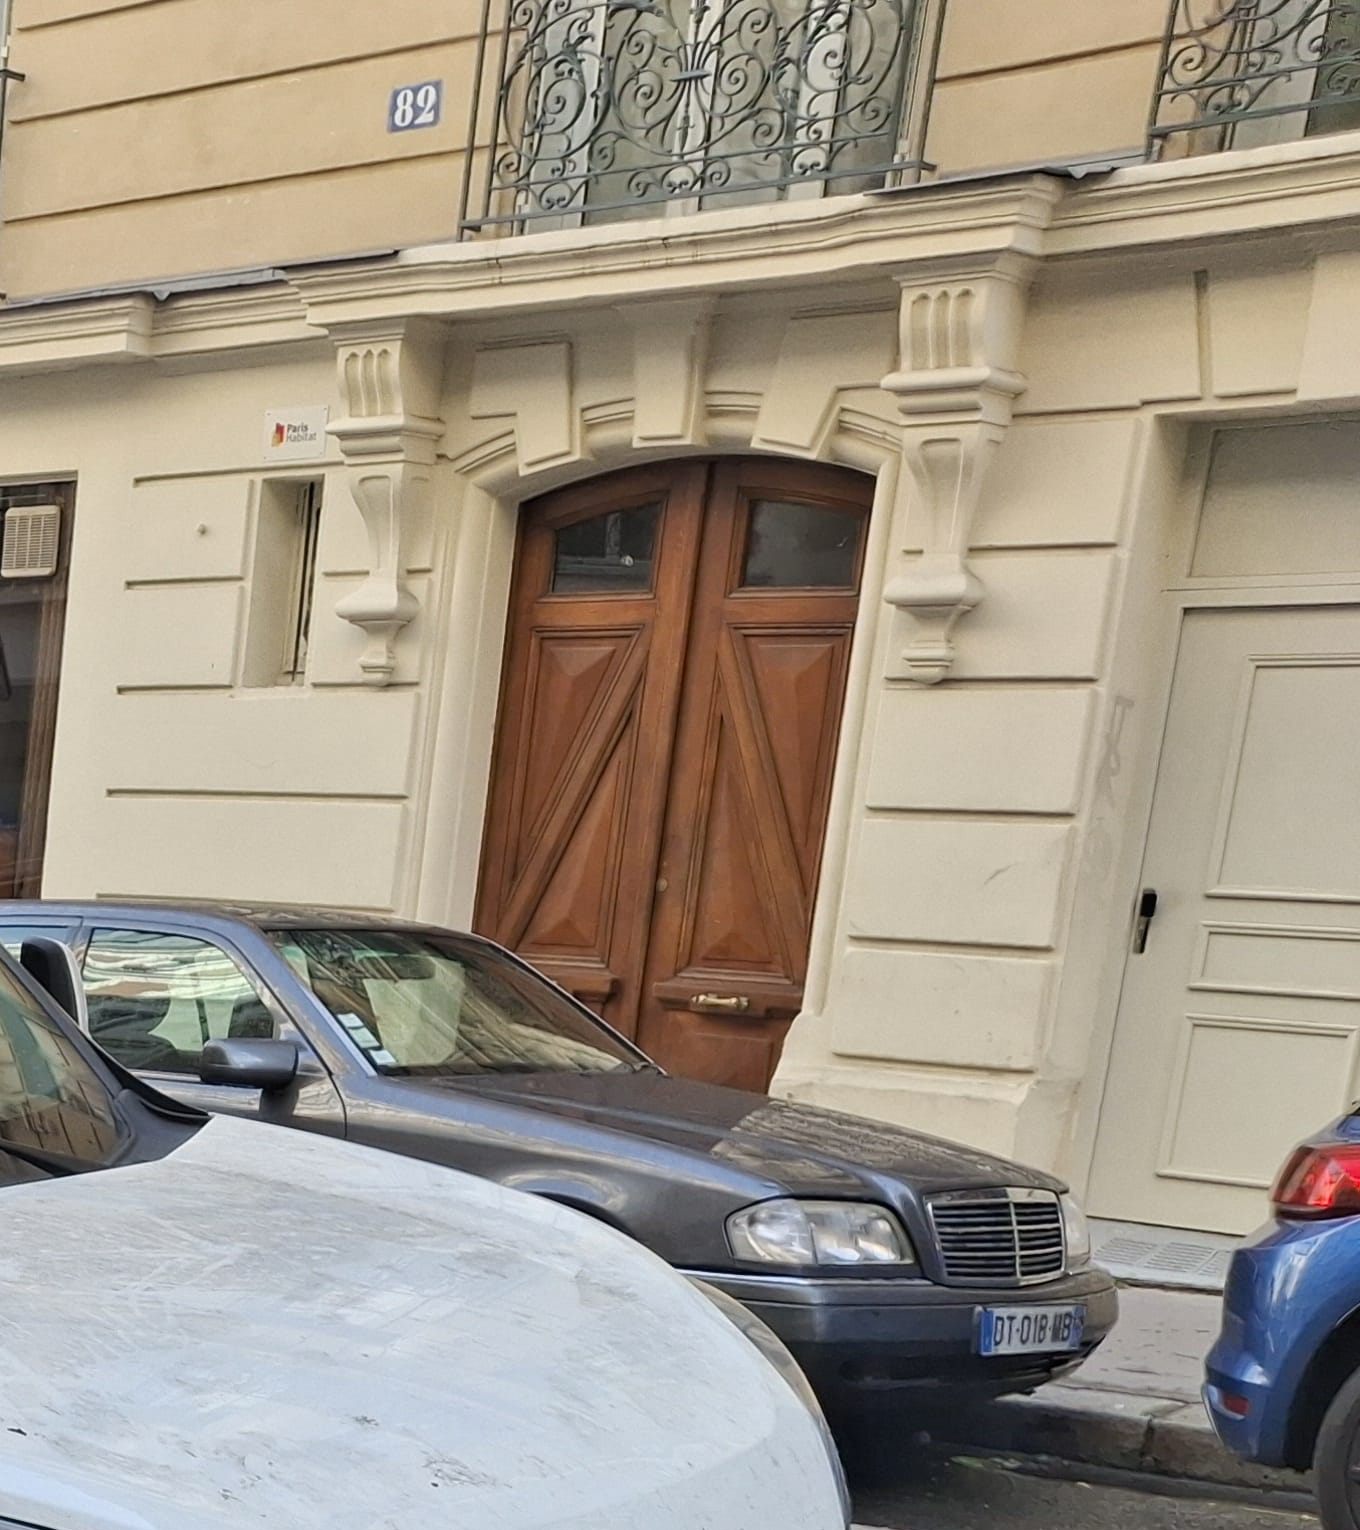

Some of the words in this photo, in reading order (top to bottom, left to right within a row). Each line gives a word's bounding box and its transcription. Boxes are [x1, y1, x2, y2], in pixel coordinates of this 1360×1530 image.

[394, 84, 437, 128] 82
[287, 422, 309, 433] Paris
[287, 432, 317, 442] Habitat
